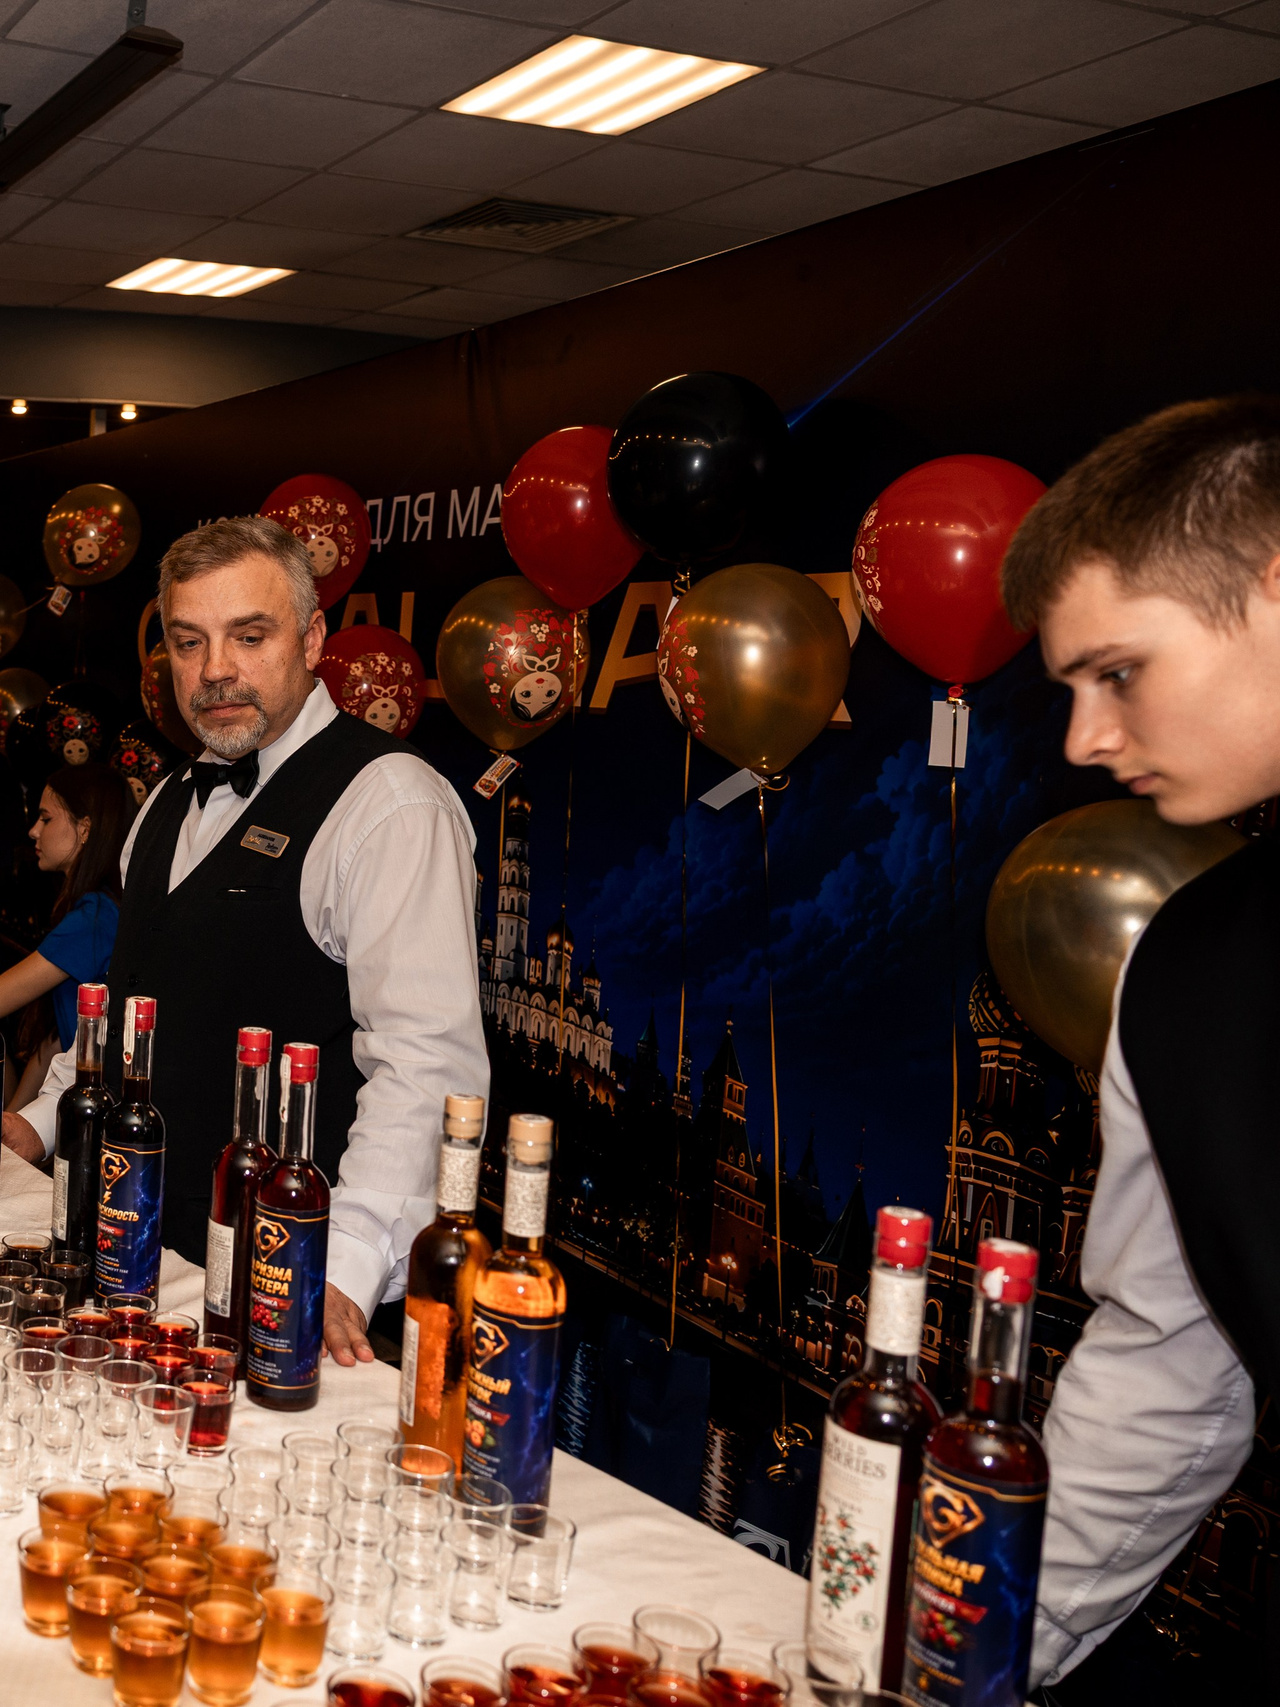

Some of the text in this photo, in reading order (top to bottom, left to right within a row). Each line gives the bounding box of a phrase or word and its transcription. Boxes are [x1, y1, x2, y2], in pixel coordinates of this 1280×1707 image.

[366, 491, 436, 553] ДЛЯ
[252, 1259, 293, 1282] РИЗМА
[252, 1273, 289, 1296] АСТЕРА
[824, 1438, 887, 1481] ERRIES
